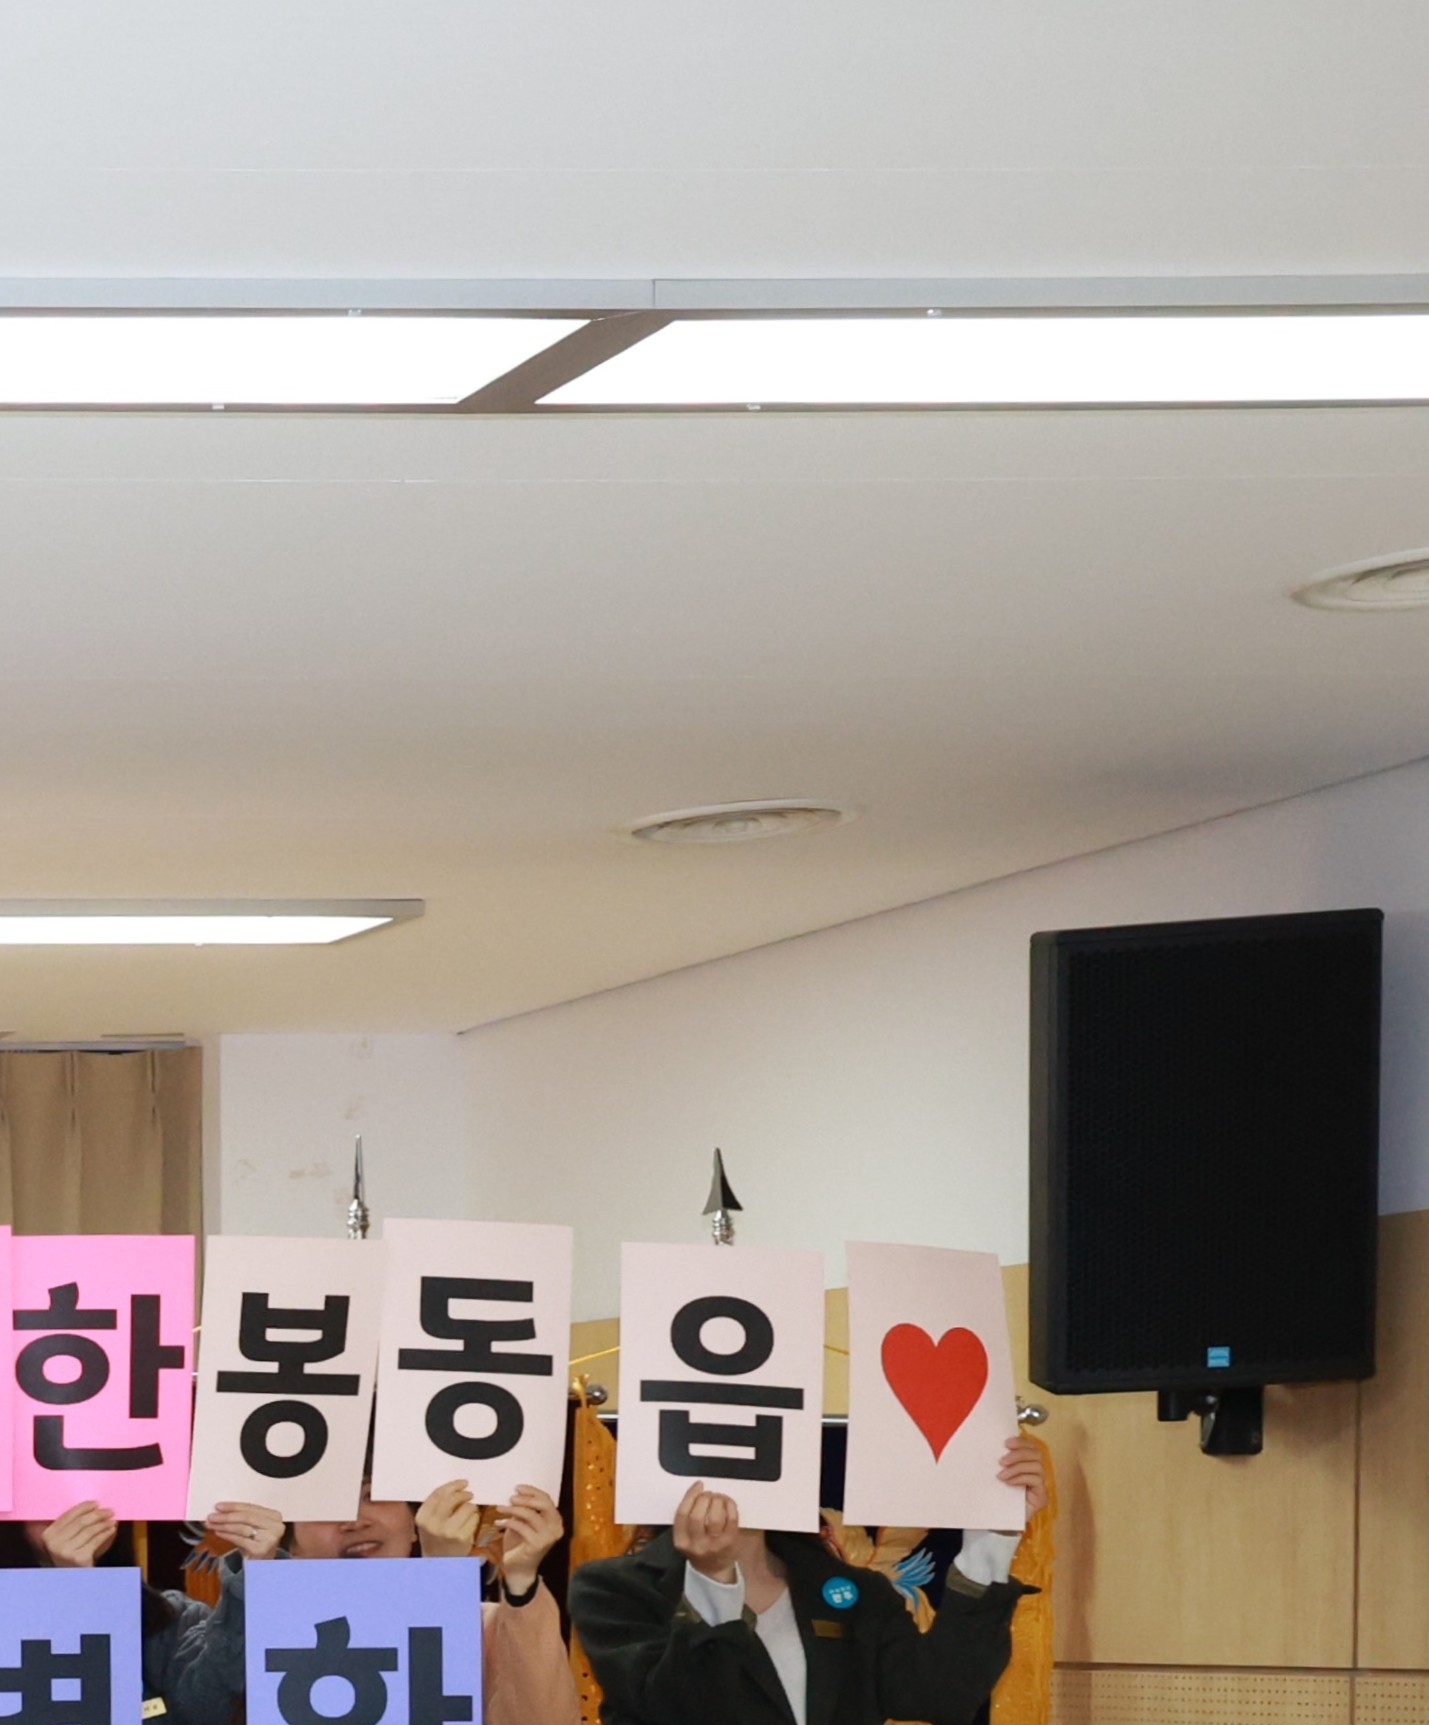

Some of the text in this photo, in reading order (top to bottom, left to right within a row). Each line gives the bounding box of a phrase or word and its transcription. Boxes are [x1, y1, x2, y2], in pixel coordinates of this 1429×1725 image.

[14, 1284, 183, 1470] 한
[217, 1293, 360, 1478] 봉
[399, 1277, 552, 1459] 동
[641, 1297, 803, 1481] 읍
